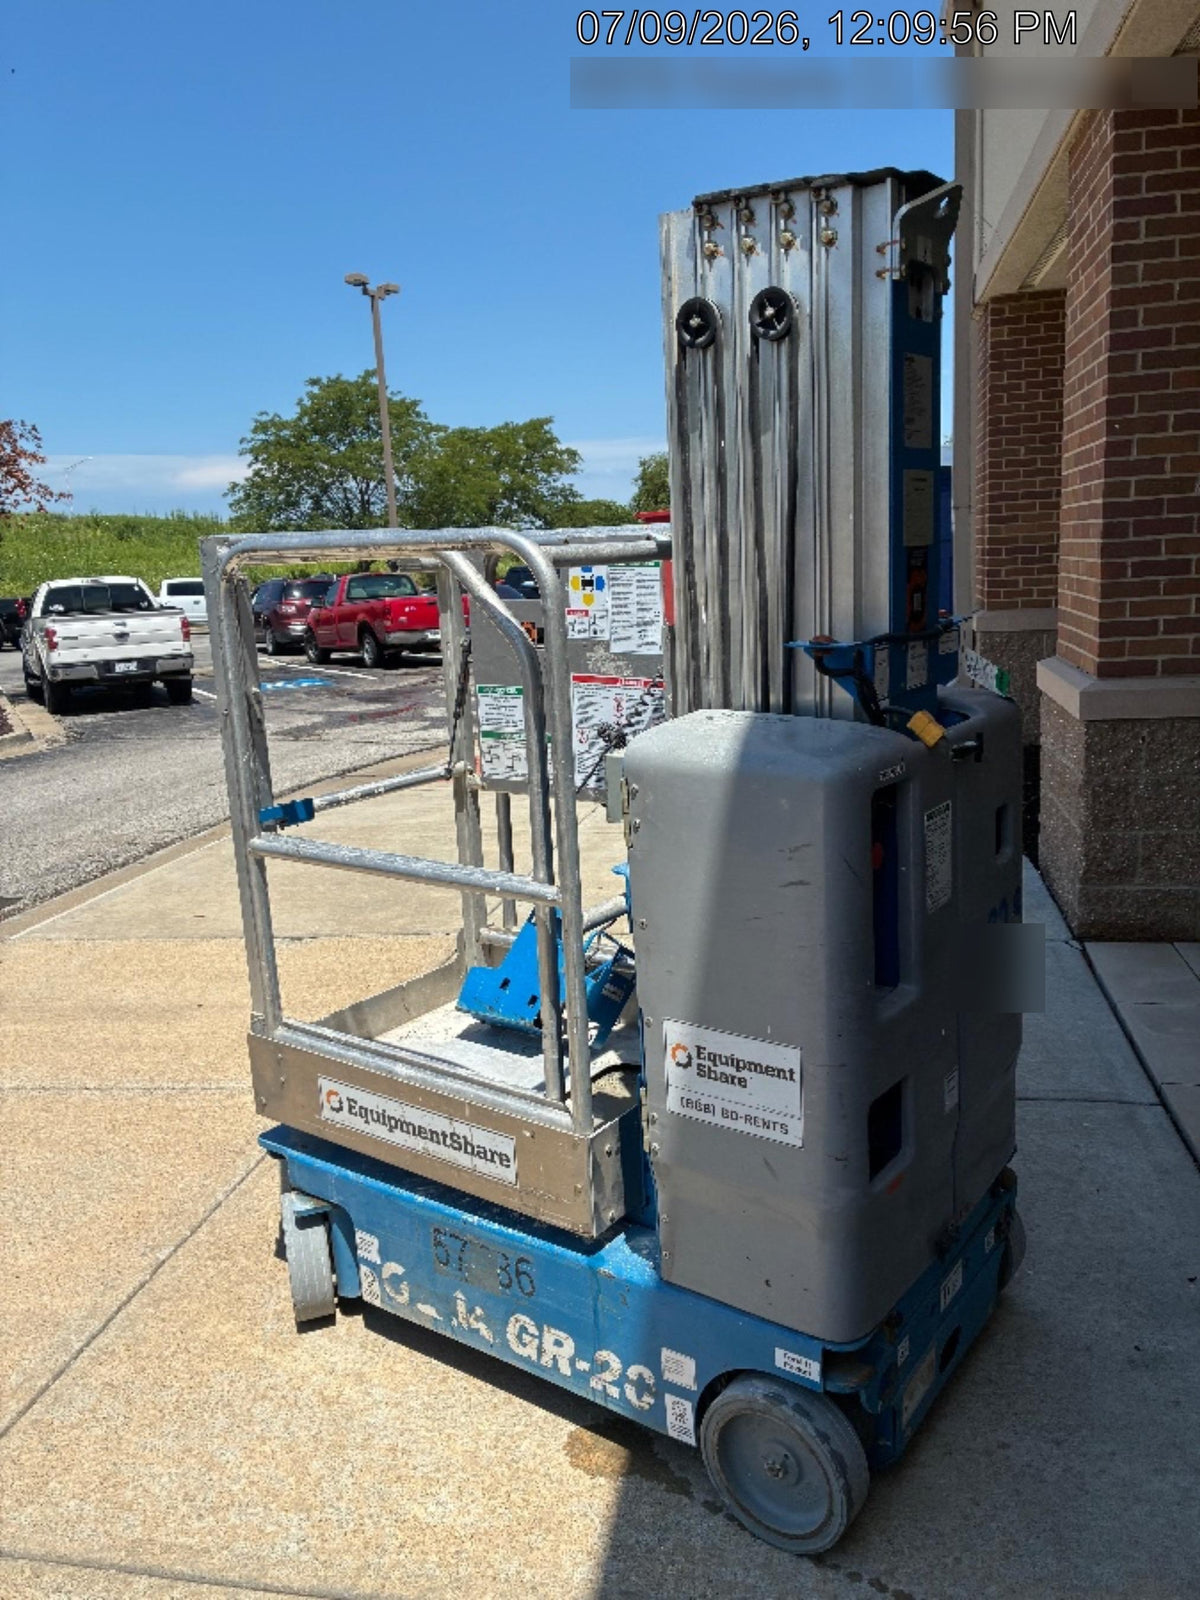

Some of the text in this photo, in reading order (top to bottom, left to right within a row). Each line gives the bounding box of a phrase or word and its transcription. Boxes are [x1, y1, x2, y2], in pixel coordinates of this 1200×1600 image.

[695, 1045, 796, 1083] Equipment
[696, 1063, 748, 1089] Share
[346, 1096, 511, 1169] EquipmentShare
